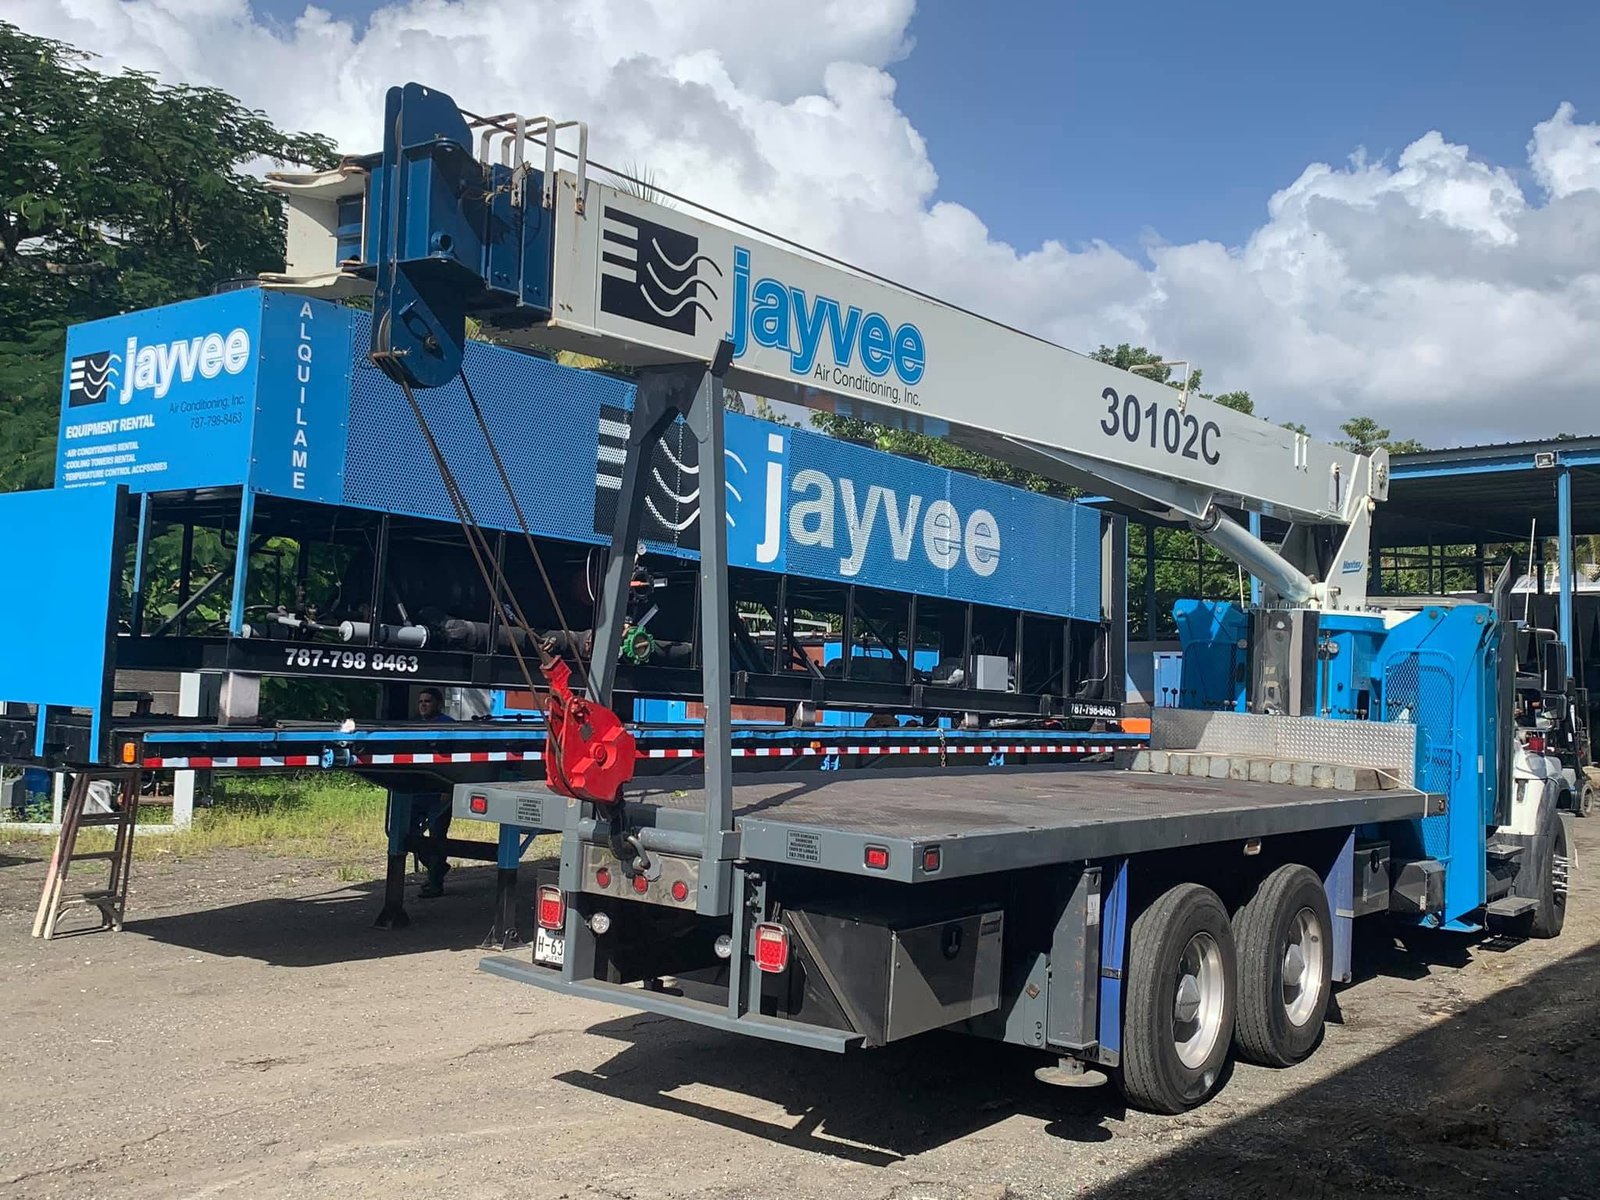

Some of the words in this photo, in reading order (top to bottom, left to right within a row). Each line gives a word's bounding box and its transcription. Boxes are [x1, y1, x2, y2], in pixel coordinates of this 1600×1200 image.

[726, 245, 925, 386] jayvee
[120, 328, 250, 404] jayvee
[292, 301, 314, 490] ALQUILAME
[814, 363, 832, 382] Air
[833, 370, 901, 402] Conditioning,
[904, 390, 922, 407] Inc.
[169, 401, 180, 414] Air
[180, 395, 230, 413] Conditioning,
[231, 395, 246, 406] Inc.
[65, 420, 119, 439] EQUIPMENT
[119, 414, 155, 432] RENTAL
[190, 412, 243, 429] 787-798-8463
[1101, 387, 1221, 466] 30102C
[77, 443, 118, 456] CONDITIONING
[117, 441, 140, 452] RENTAL
[91, 456, 114, 467] TOWERS
[114, 454, 136, 463] RENTAL
[104, 466, 131, 477] CONTROL
[756, 433, 1000, 577] jayvee
[285, 648, 366, 670] 787-798
[371, 653, 419, 673] 8463
[1071, 703, 1116, 717] 787-798-8463
[537, 935, 564, 956] H-63
